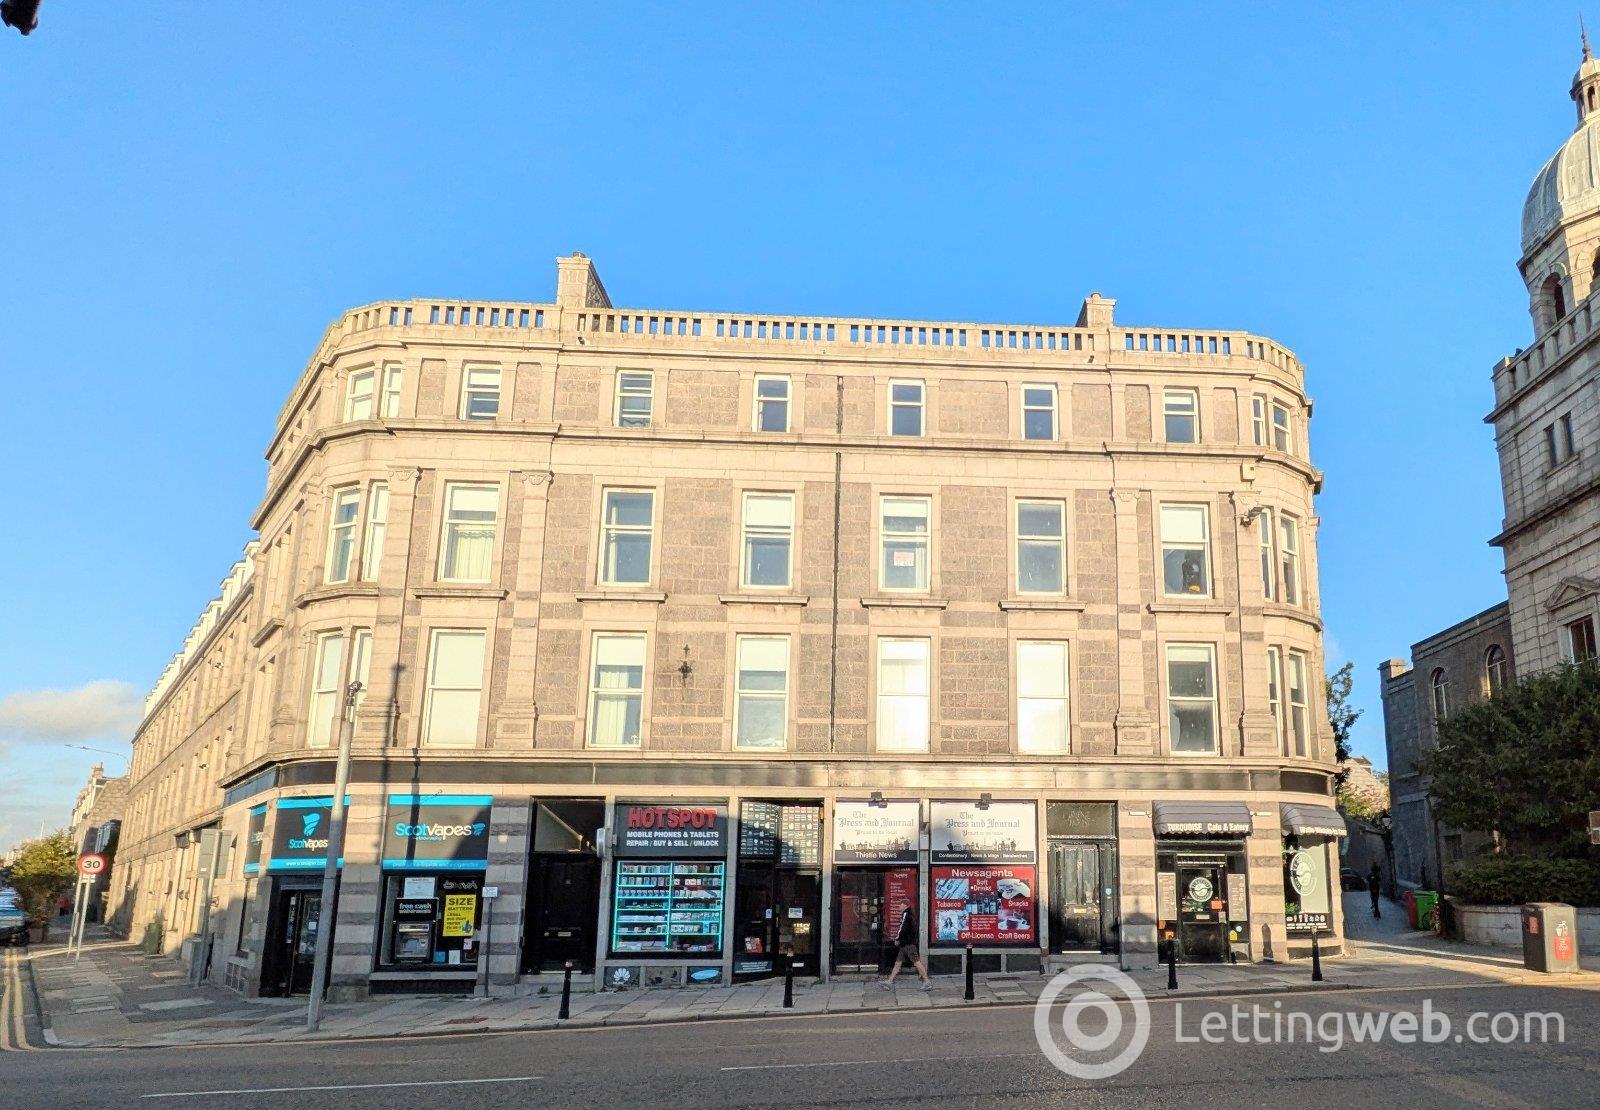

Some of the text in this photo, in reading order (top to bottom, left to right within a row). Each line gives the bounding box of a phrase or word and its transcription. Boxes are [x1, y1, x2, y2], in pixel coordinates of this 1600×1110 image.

[628, 807, 718, 829] HOTSPOT
[945, 818, 1020, 829] Press and Journal
[1167, 823, 1203, 832] TURQUOISE
[84, 860, 100, 868] 30
[952, 868, 1014, 878] Newsagents
[448, 898, 474, 906] SIZE
